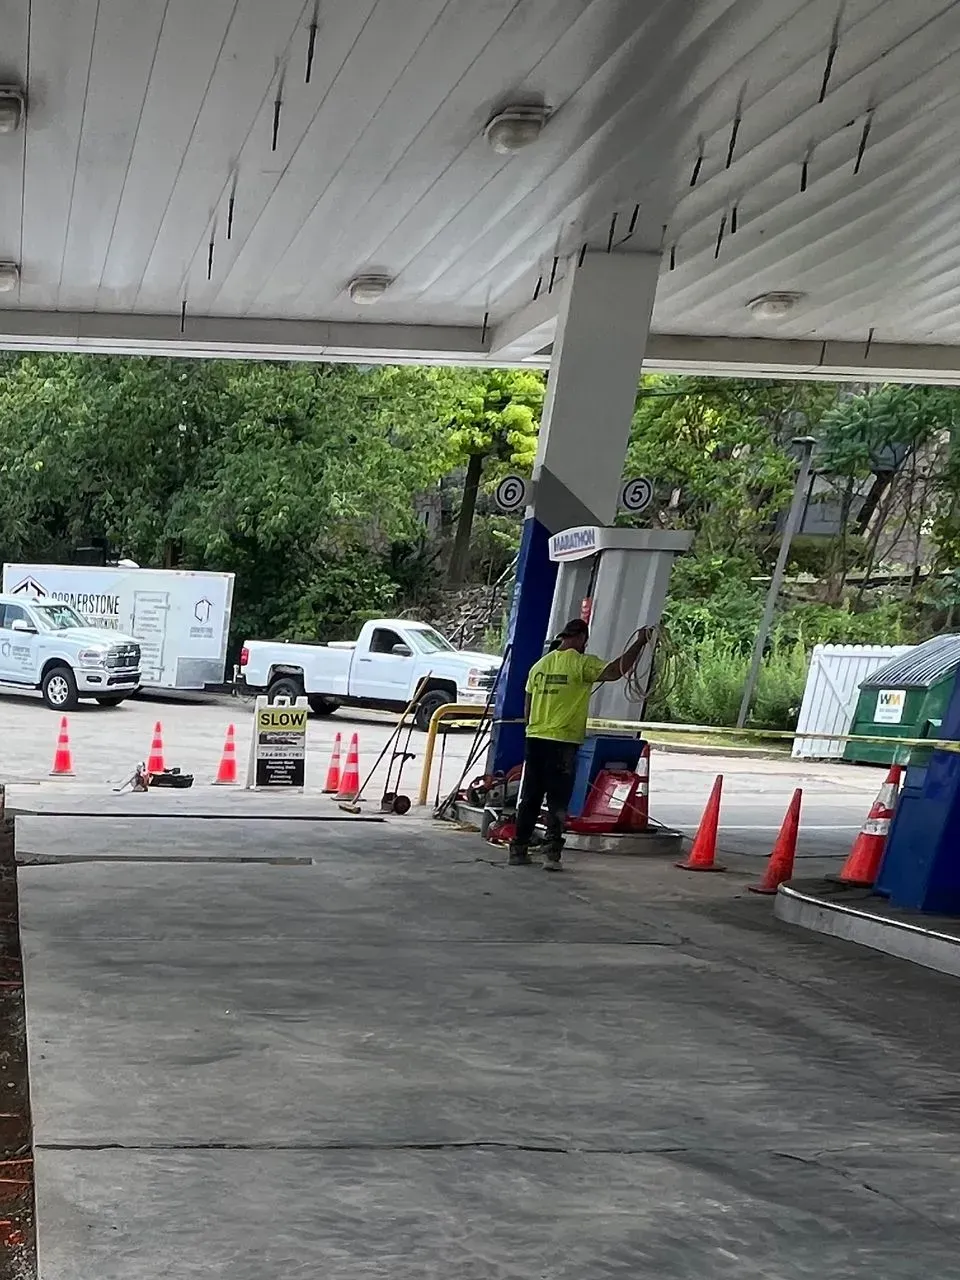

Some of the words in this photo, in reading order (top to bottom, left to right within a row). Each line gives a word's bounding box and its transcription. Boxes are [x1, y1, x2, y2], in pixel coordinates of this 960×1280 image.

[504, 482, 518, 500] 6
[630, 485, 645, 503] 5
[553, 530, 596, 553] MARATHON
[260, 713, 305, 726] SLOW
